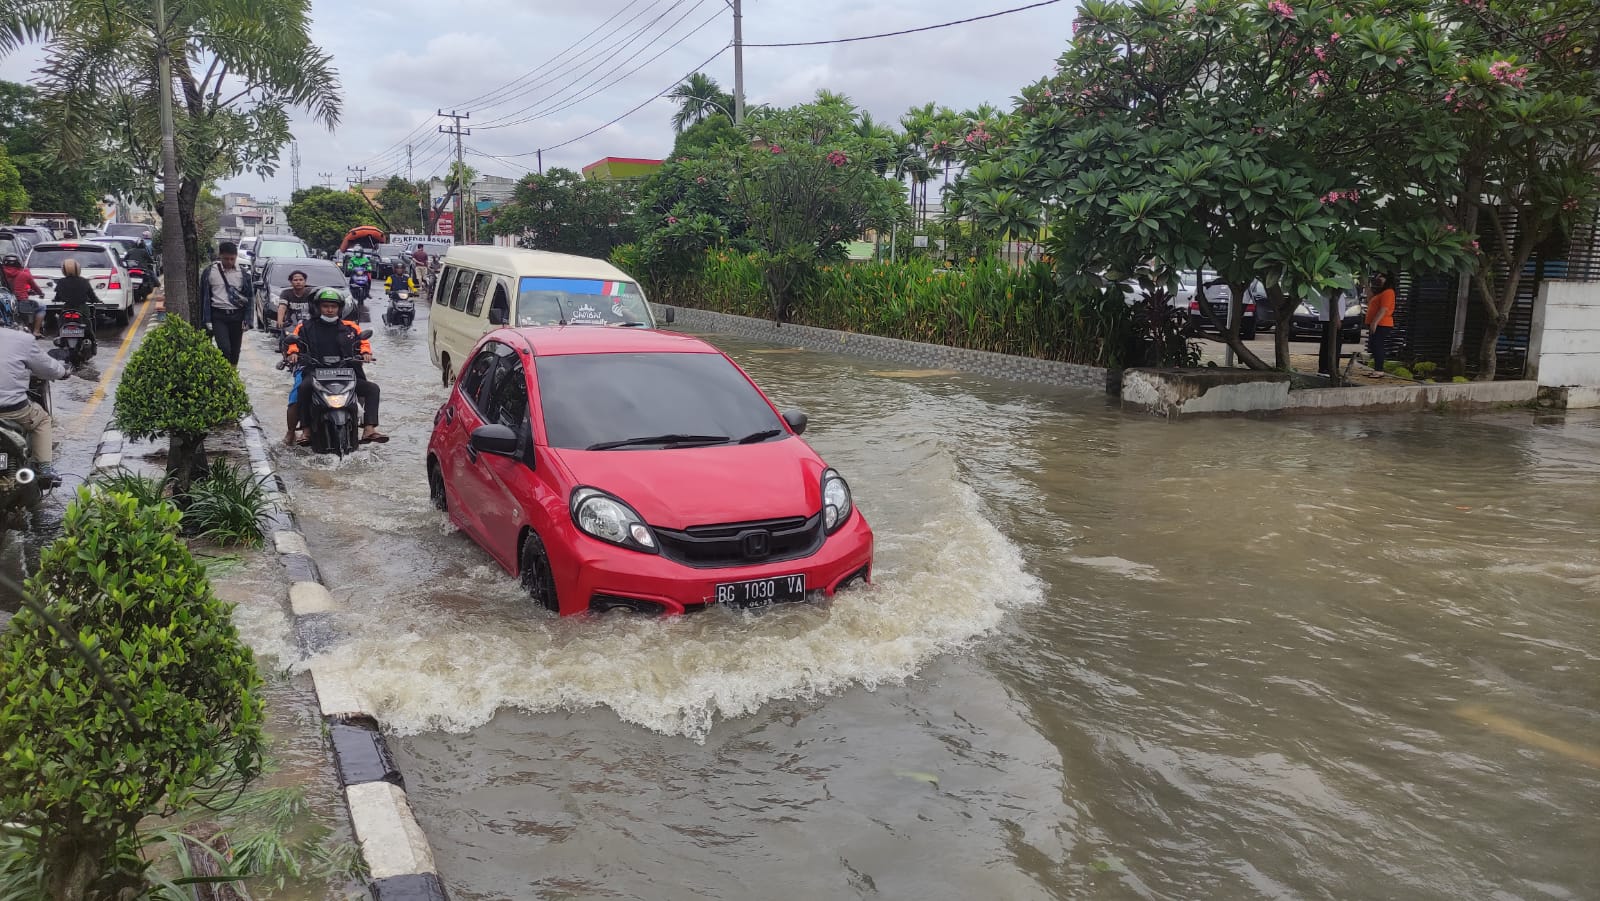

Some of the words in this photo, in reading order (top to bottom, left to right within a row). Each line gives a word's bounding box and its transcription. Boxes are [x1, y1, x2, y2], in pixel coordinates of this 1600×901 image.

[718, 585, 735, 602] BG
[745, 580, 775, 600] 1030
[787, 576, 803, 593] VA
